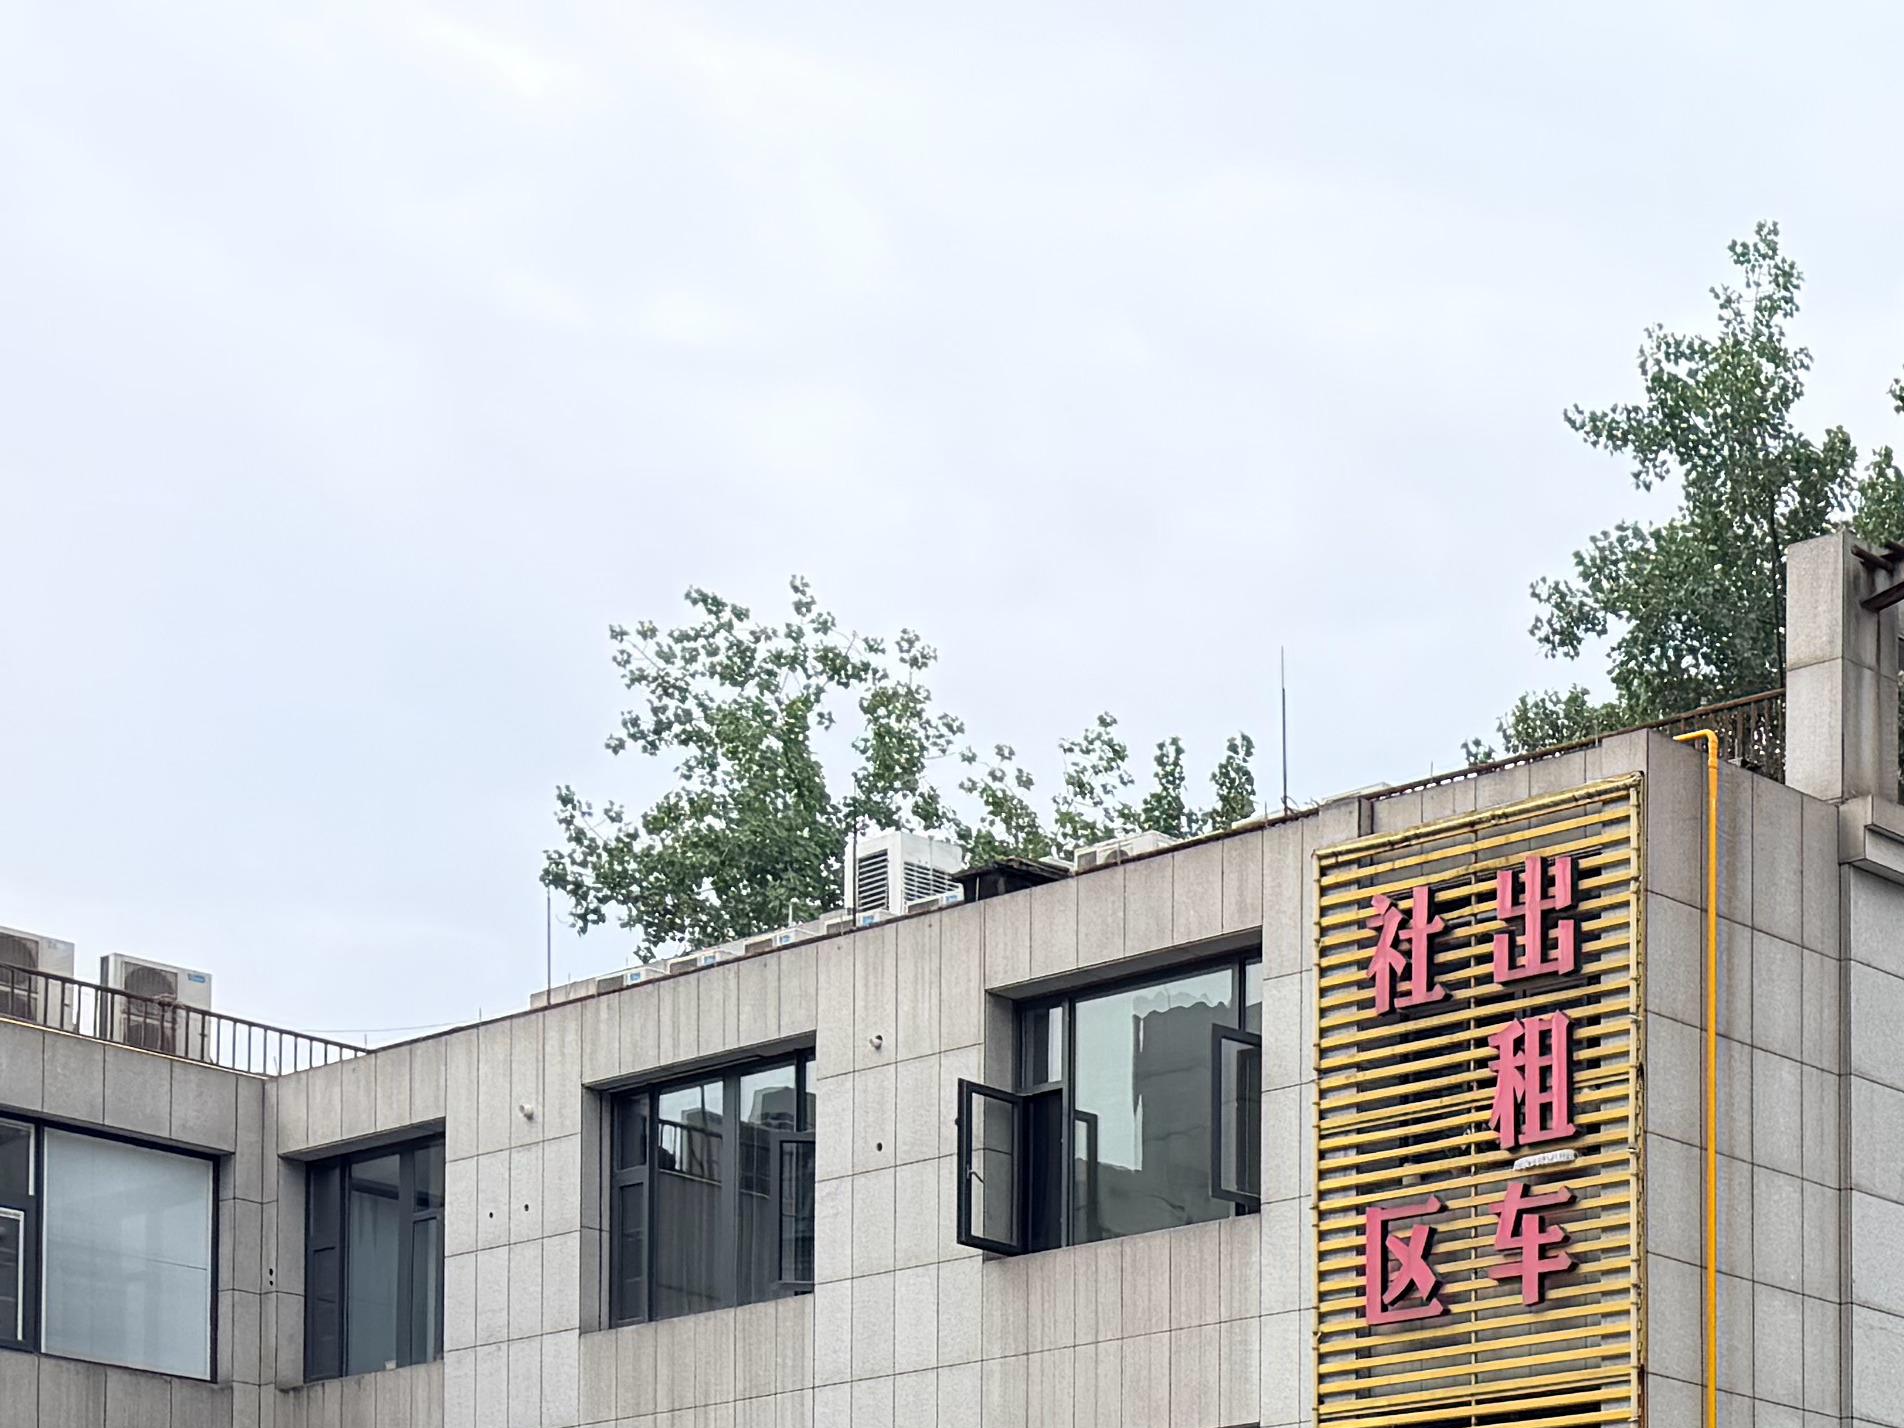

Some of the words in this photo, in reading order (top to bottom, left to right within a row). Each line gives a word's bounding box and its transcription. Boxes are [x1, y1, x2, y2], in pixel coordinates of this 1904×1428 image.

[1365, 886, 1449, 1325] 社区
[1488, 856, 1583, 1305] 出租车
